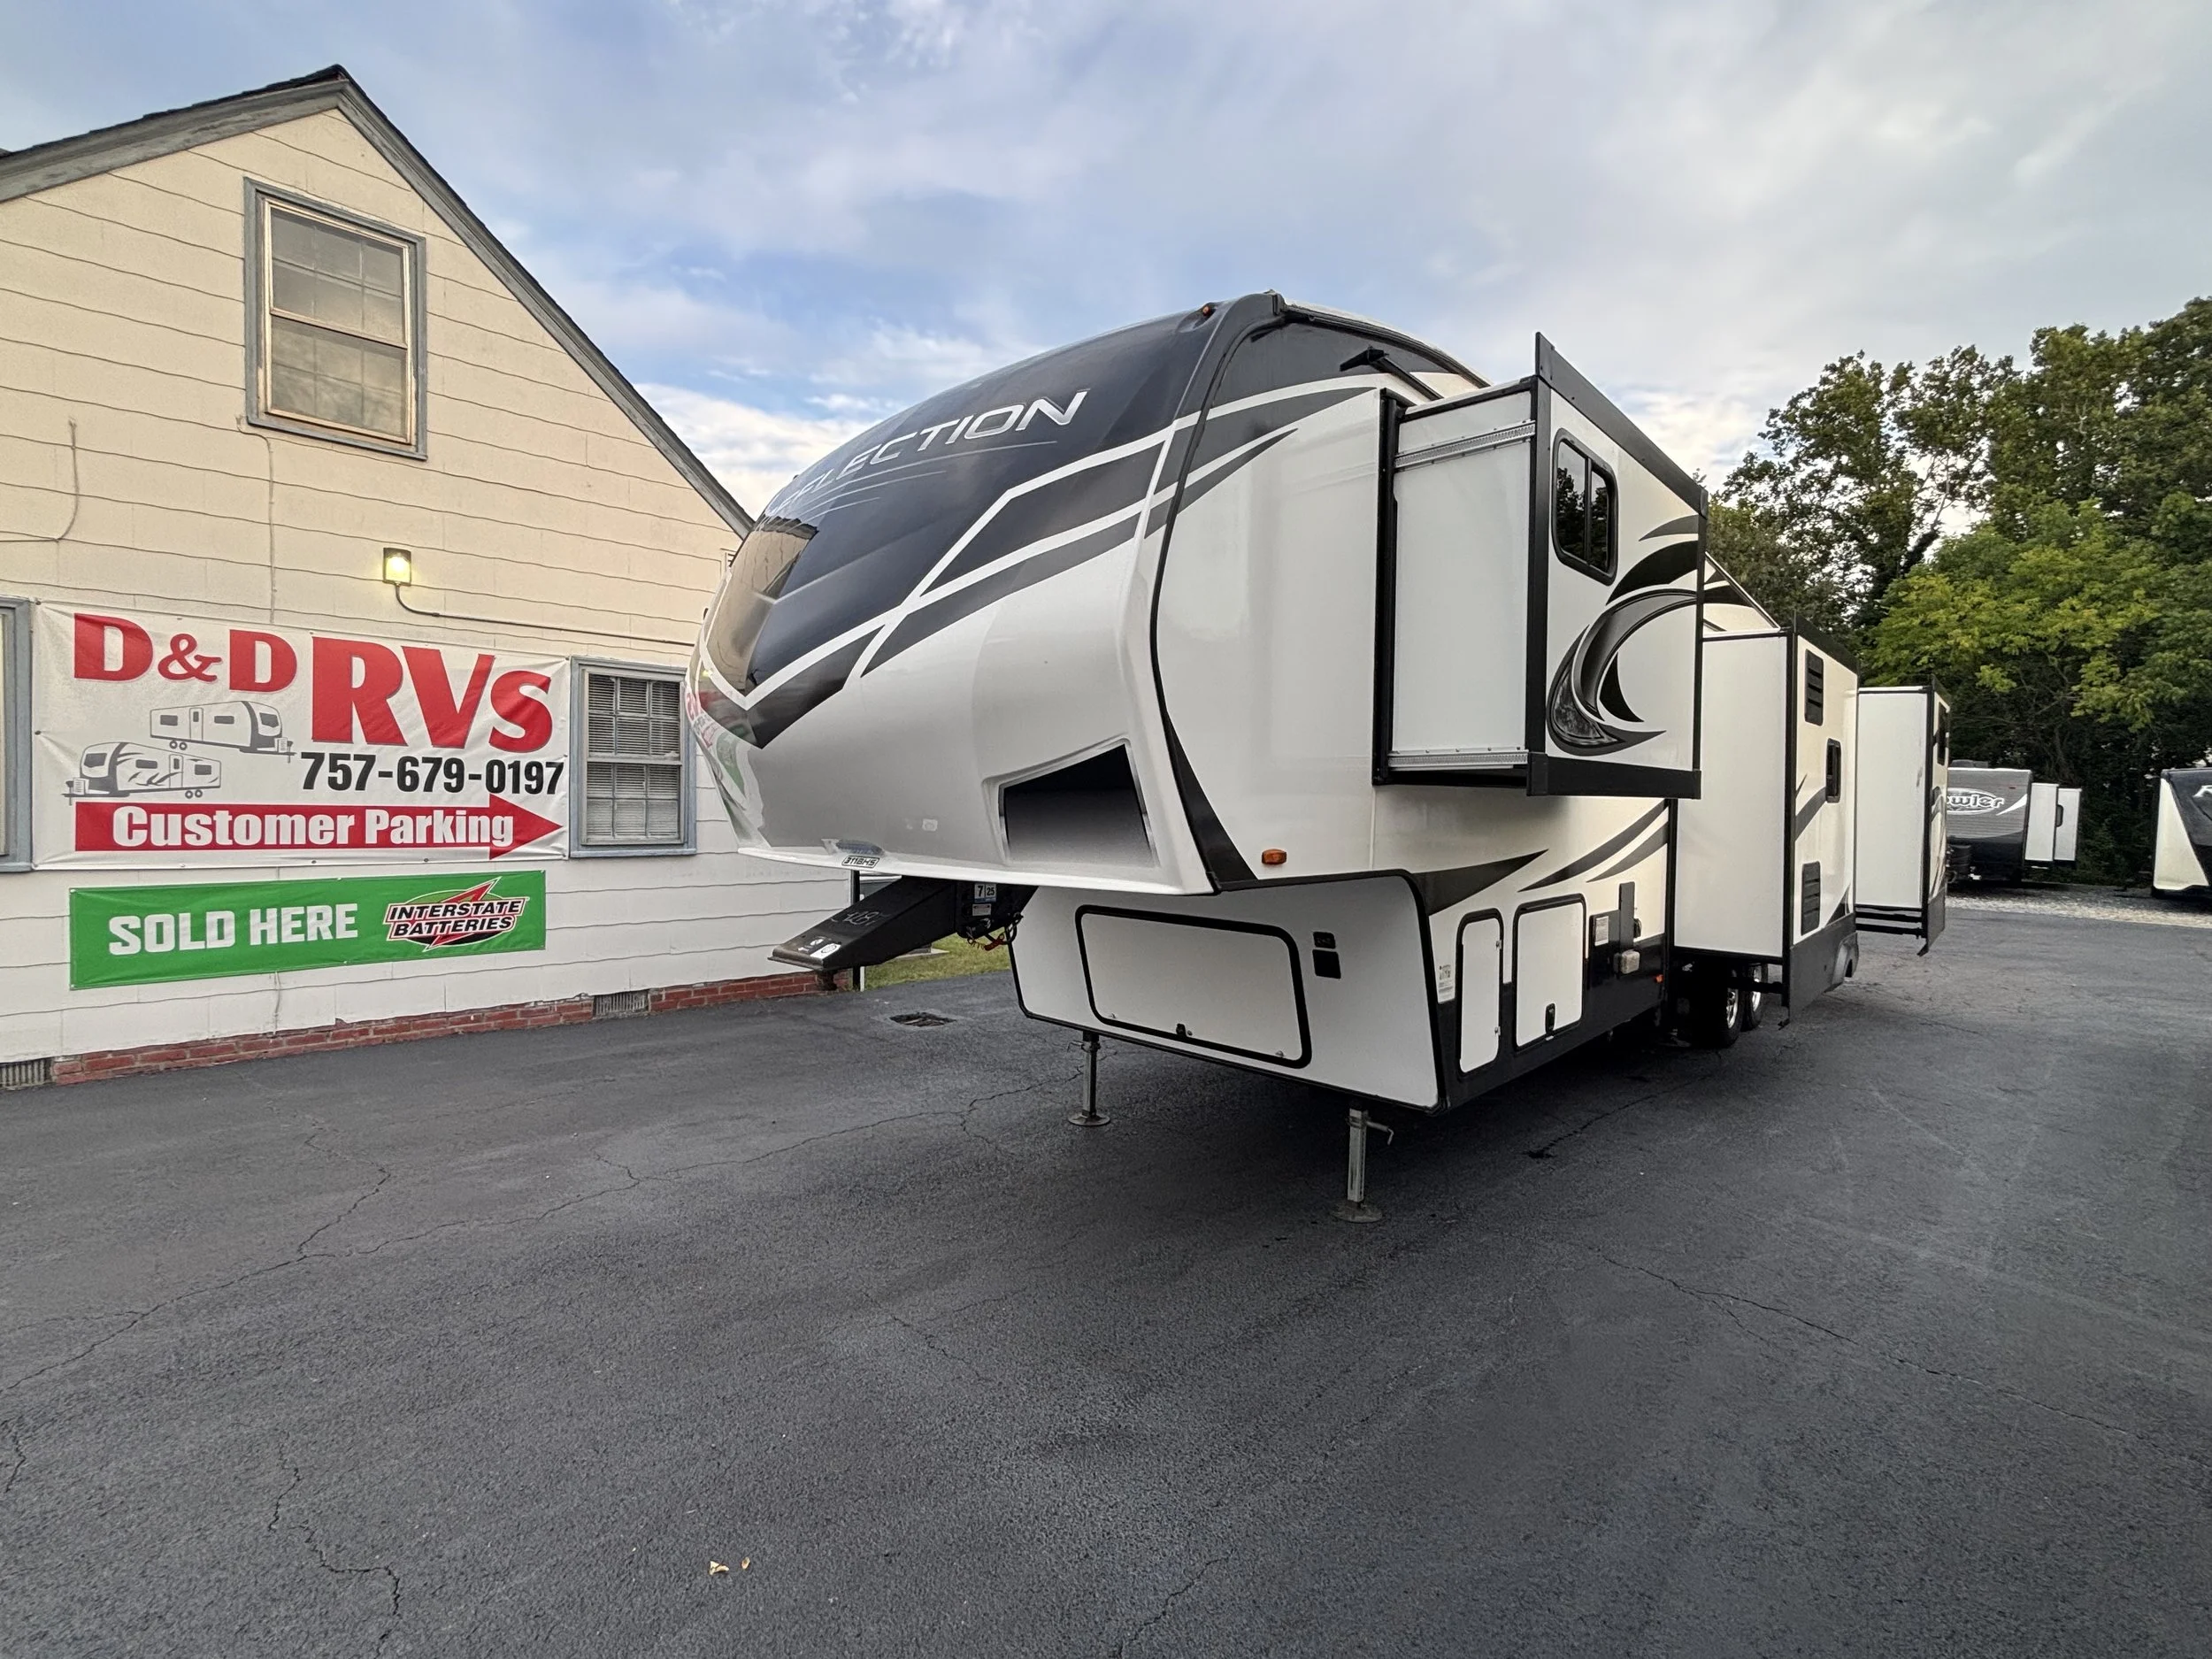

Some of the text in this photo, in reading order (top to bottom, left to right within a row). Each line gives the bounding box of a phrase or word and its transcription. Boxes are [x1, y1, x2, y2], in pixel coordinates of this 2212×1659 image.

[73, 612, 297, 693] D&D
[301, 751, 565, 795] 757-679-0197
[1947, 795, 2005, 808] wler
[112, 806, 514, 847] Customer Parking
[978, 885, 995, 897] 7 25
[389, 900, 522, 921] INTERSTATE
[109, 903, 357, 956] SOLD HERE
[394, 916, 513, 938] BATTERIES
